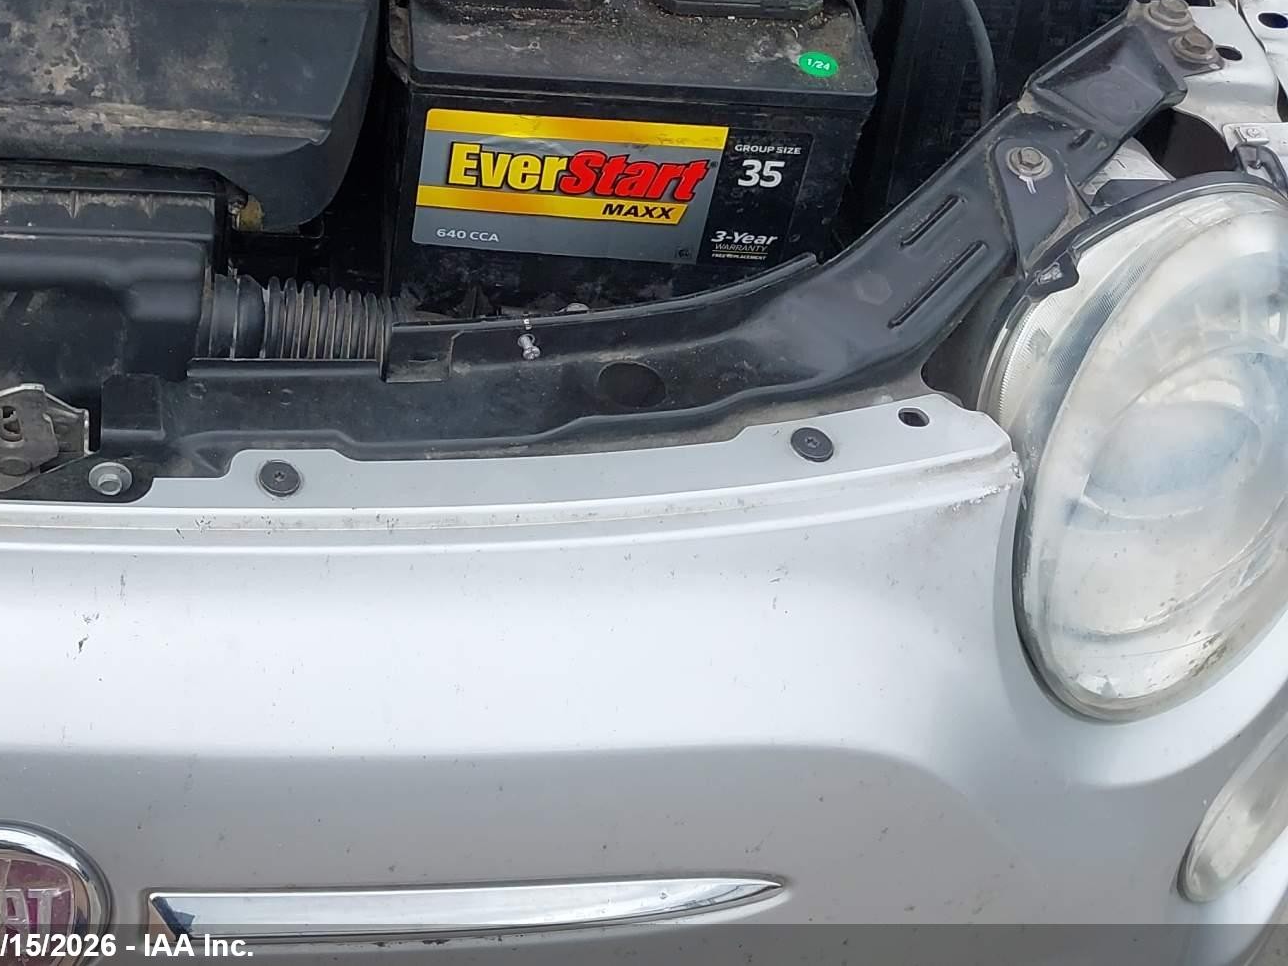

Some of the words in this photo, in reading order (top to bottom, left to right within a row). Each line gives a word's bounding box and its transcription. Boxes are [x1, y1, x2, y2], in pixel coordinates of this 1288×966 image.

[806, 57, 831, 72] 1/24
[734, 144, 775, 153] GROUP
[776, 146, 802, 155] SIZE
[447, 140, 710, 203] EverStart
[738, 159, 785, 188] 35
[601, 202, 675, 220] MAXX
[436, 227, 466, 240] 640
[470, 230, 500, 243] CCA
[711, 230, 778, 246] 3-Year
[714, 243, 768, 252] WARRANTY
